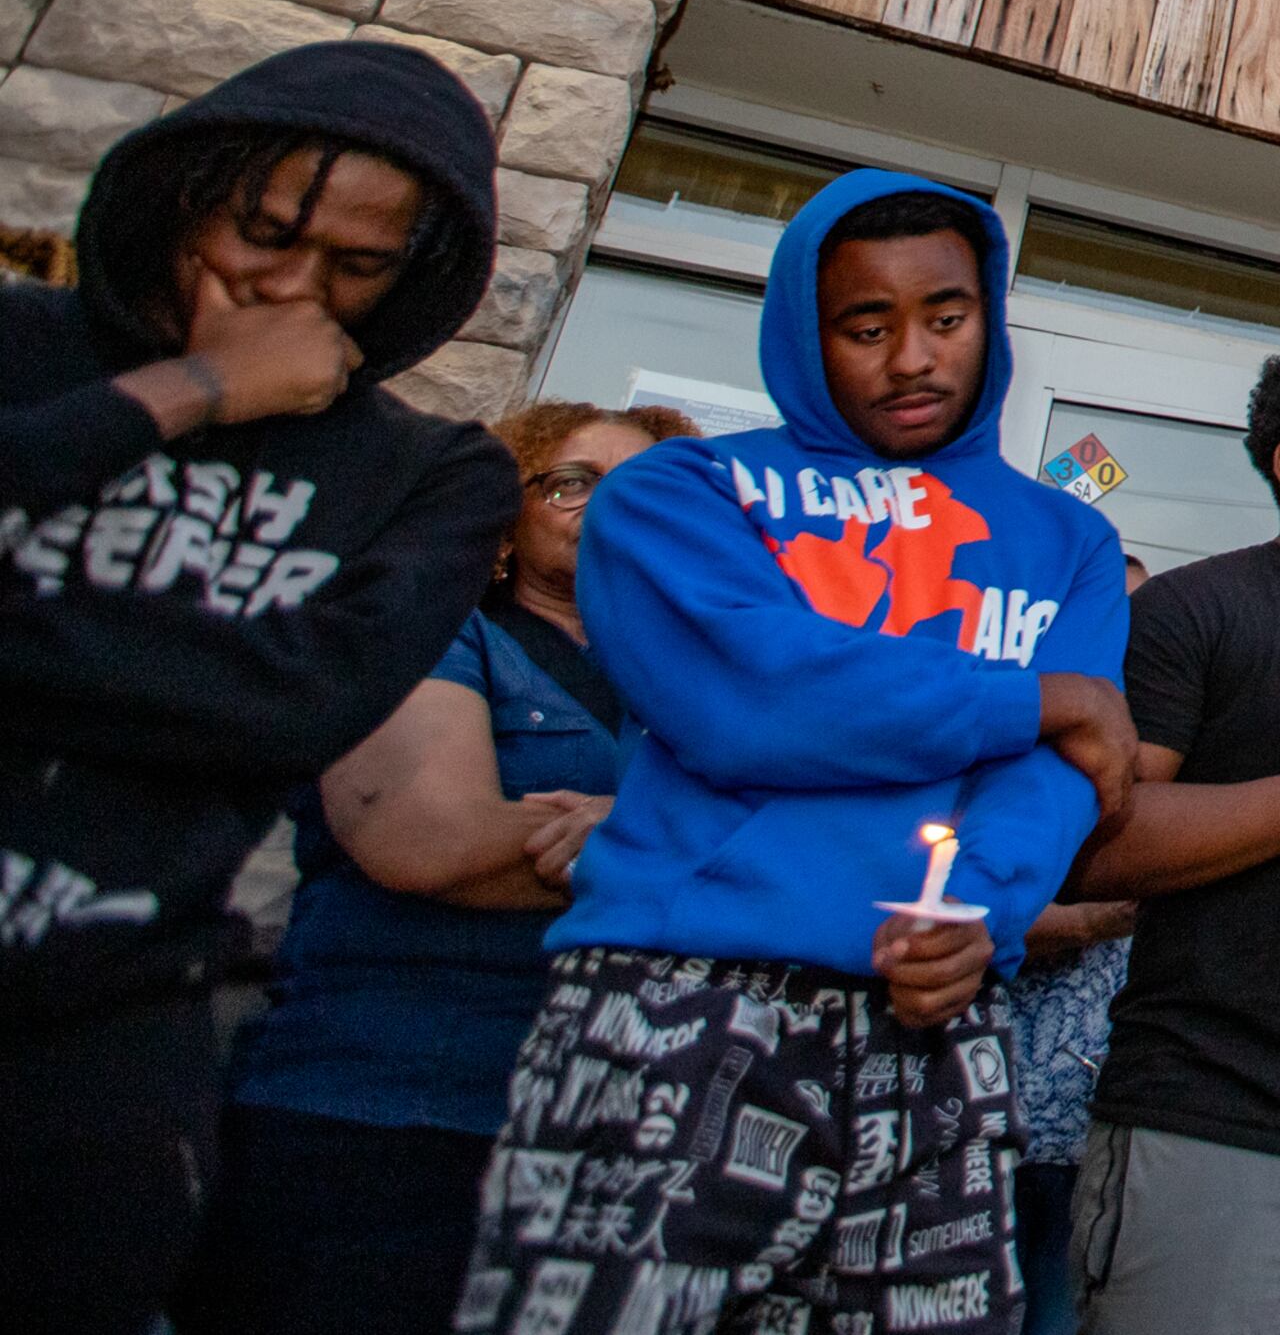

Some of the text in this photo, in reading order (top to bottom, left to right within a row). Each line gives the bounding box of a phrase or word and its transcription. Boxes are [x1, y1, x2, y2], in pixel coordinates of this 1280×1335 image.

[1056, 457, 1116, 486] 3 0
[1079, 441, 1097, 464] 0
[797, 466, 932, 530] CARE
[1073, 481, 1092, 500] SA
[907, 1210, 994, 1257] SOMEWHERE
[886, 1269, 991, 1331] NOWHERE
